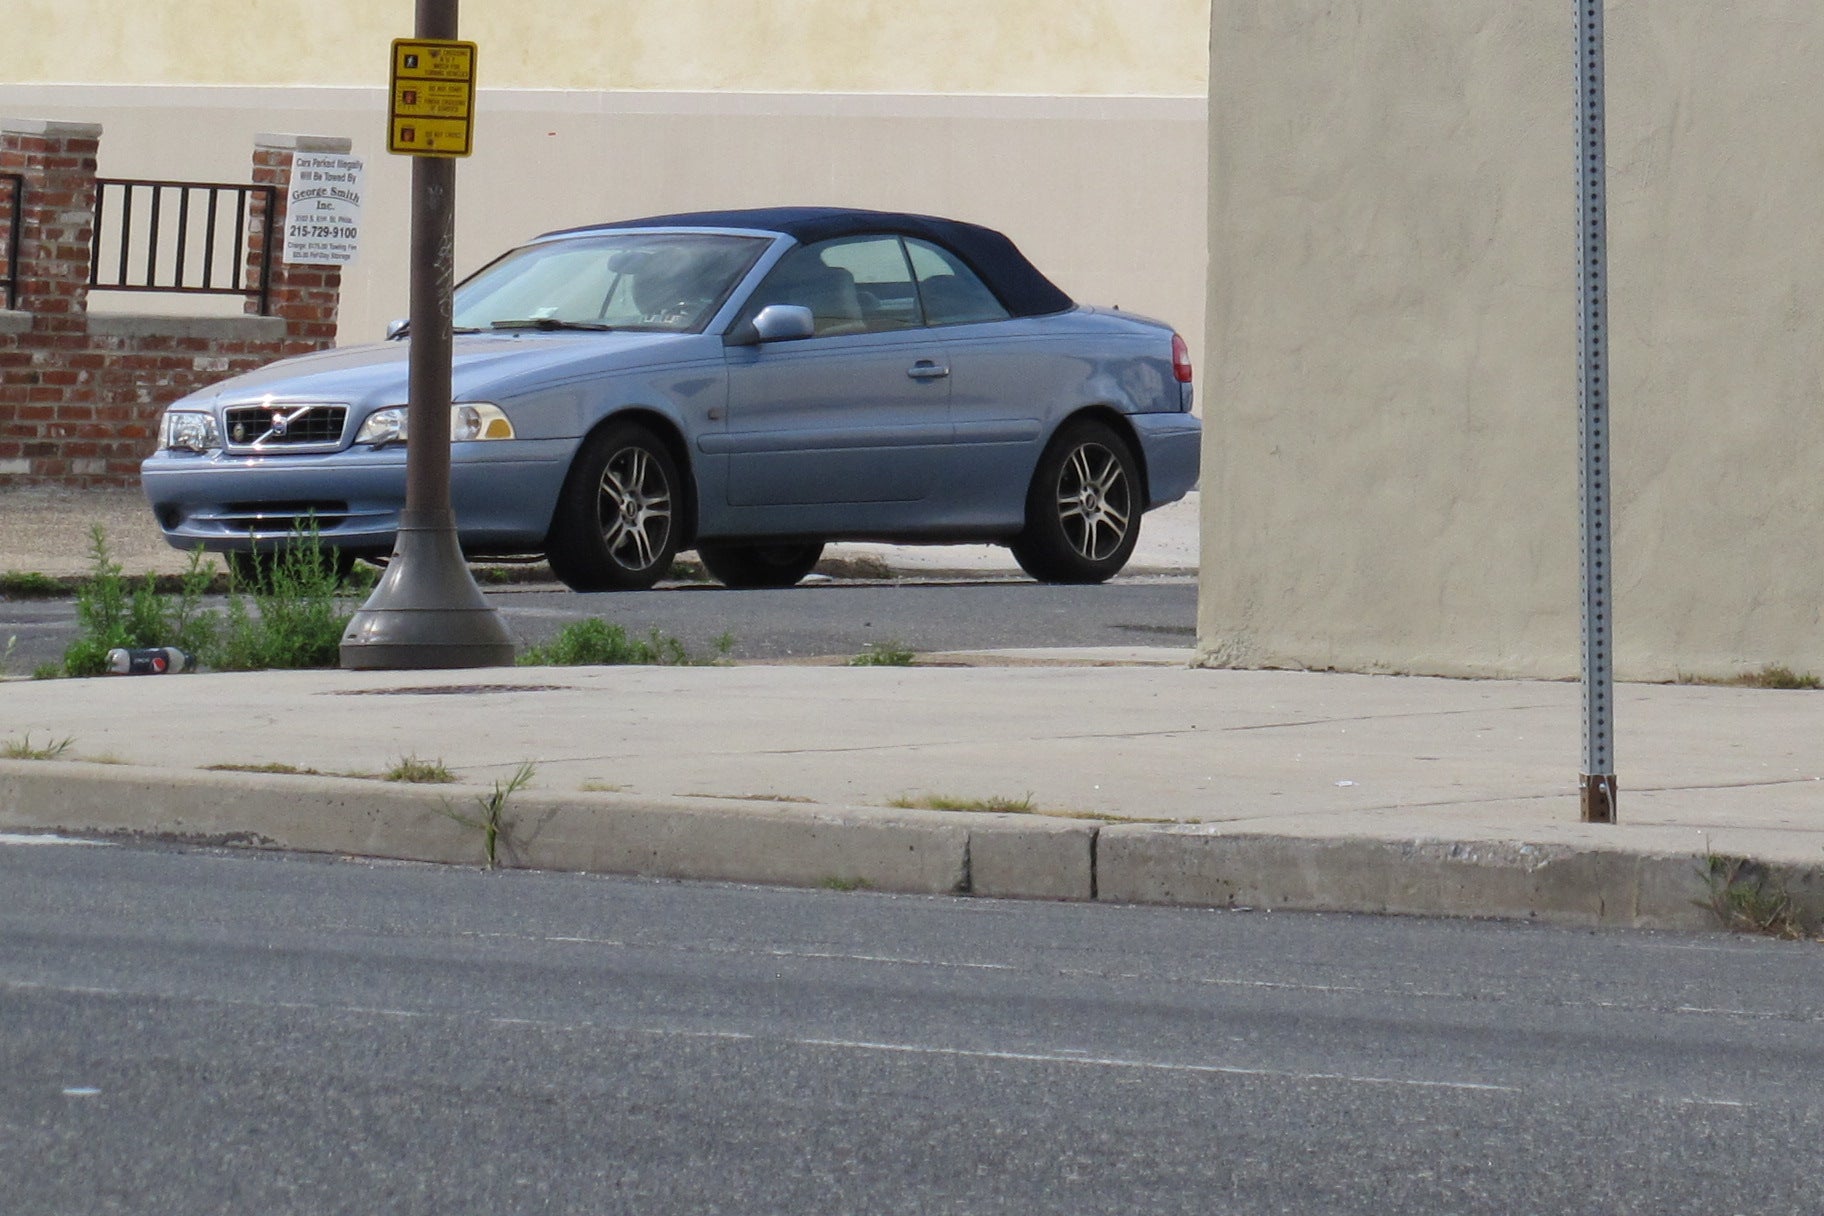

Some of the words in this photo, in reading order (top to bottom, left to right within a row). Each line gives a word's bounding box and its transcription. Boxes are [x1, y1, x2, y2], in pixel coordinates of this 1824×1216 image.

[296, 158, 312, 167] Cars
[313, 158, 336, 168] Parked
[313, 171, 323, 181] Be
[324, 171, 346, 182] Towed
[347, 173, 357, 185] By
[292, 187, 328, 200] George
[330, 186, 360, 203] Smith
[316, 200, 335, 210] Inc.
[289, 224, 358, 239] 215-729-9100
